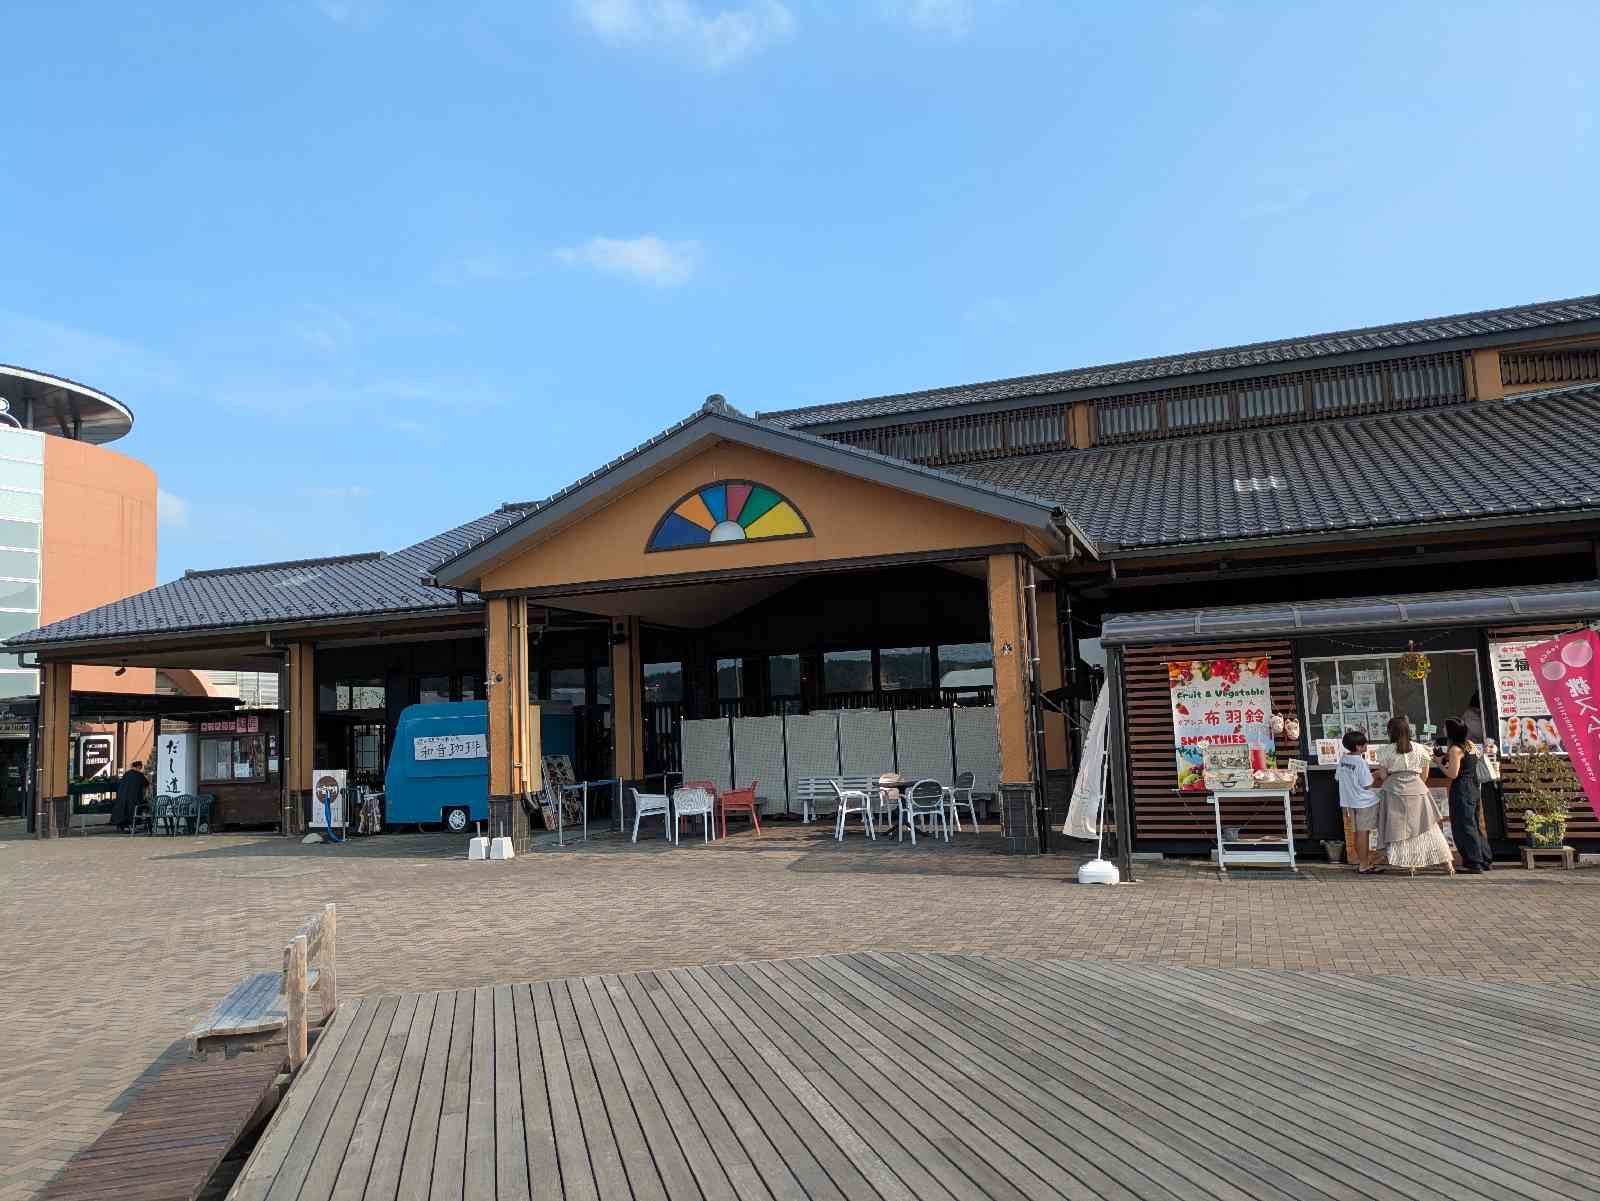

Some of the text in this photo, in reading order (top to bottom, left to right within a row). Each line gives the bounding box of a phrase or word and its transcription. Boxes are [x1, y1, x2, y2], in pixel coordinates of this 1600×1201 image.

[1176, 690, 1201, 699] Fruit
[1215, 688, 1265, 699] Vegetable
[1204, 709, 1264, 726] 布羽鈴
[1180, 735, 1247, 746] SMOOTHIES
[165, 739, 181, 793] だし道
